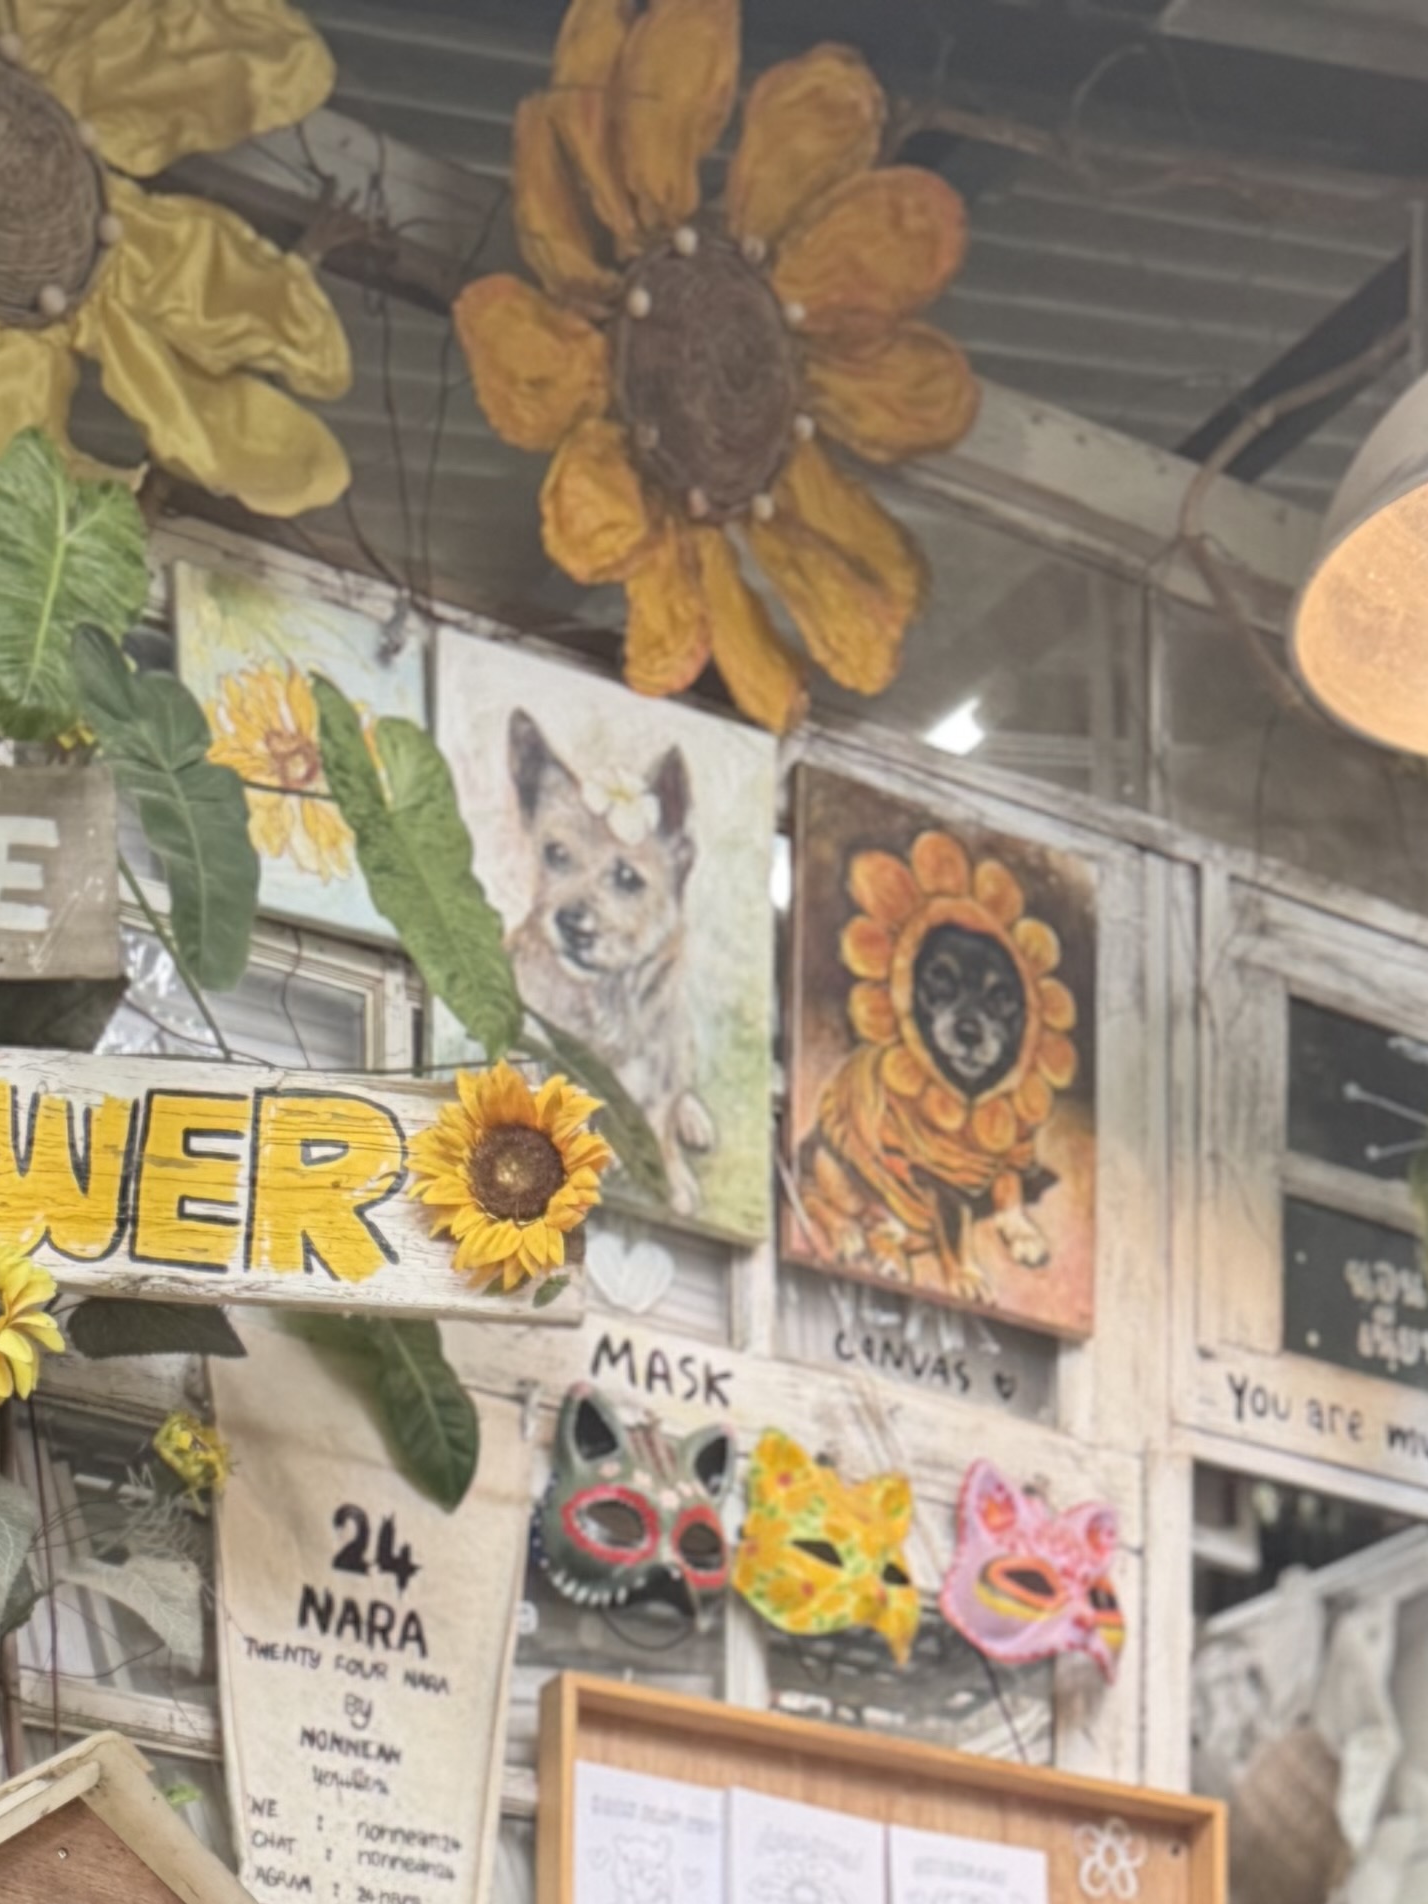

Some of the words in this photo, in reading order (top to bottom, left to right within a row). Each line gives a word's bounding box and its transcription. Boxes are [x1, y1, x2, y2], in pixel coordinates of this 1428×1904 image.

[590, 1333, 733, 1408] MASK
[1226, 1372, 1290, 1421] You
[1305, 1398, 1364, 1442] are
[332, 1504, 421, 1592] 24
[244, 1636, 321, 1669] TWENTY
[335, 1655, 387, 1680] FOUR
[298, 1584, 428, 1658] NARA
